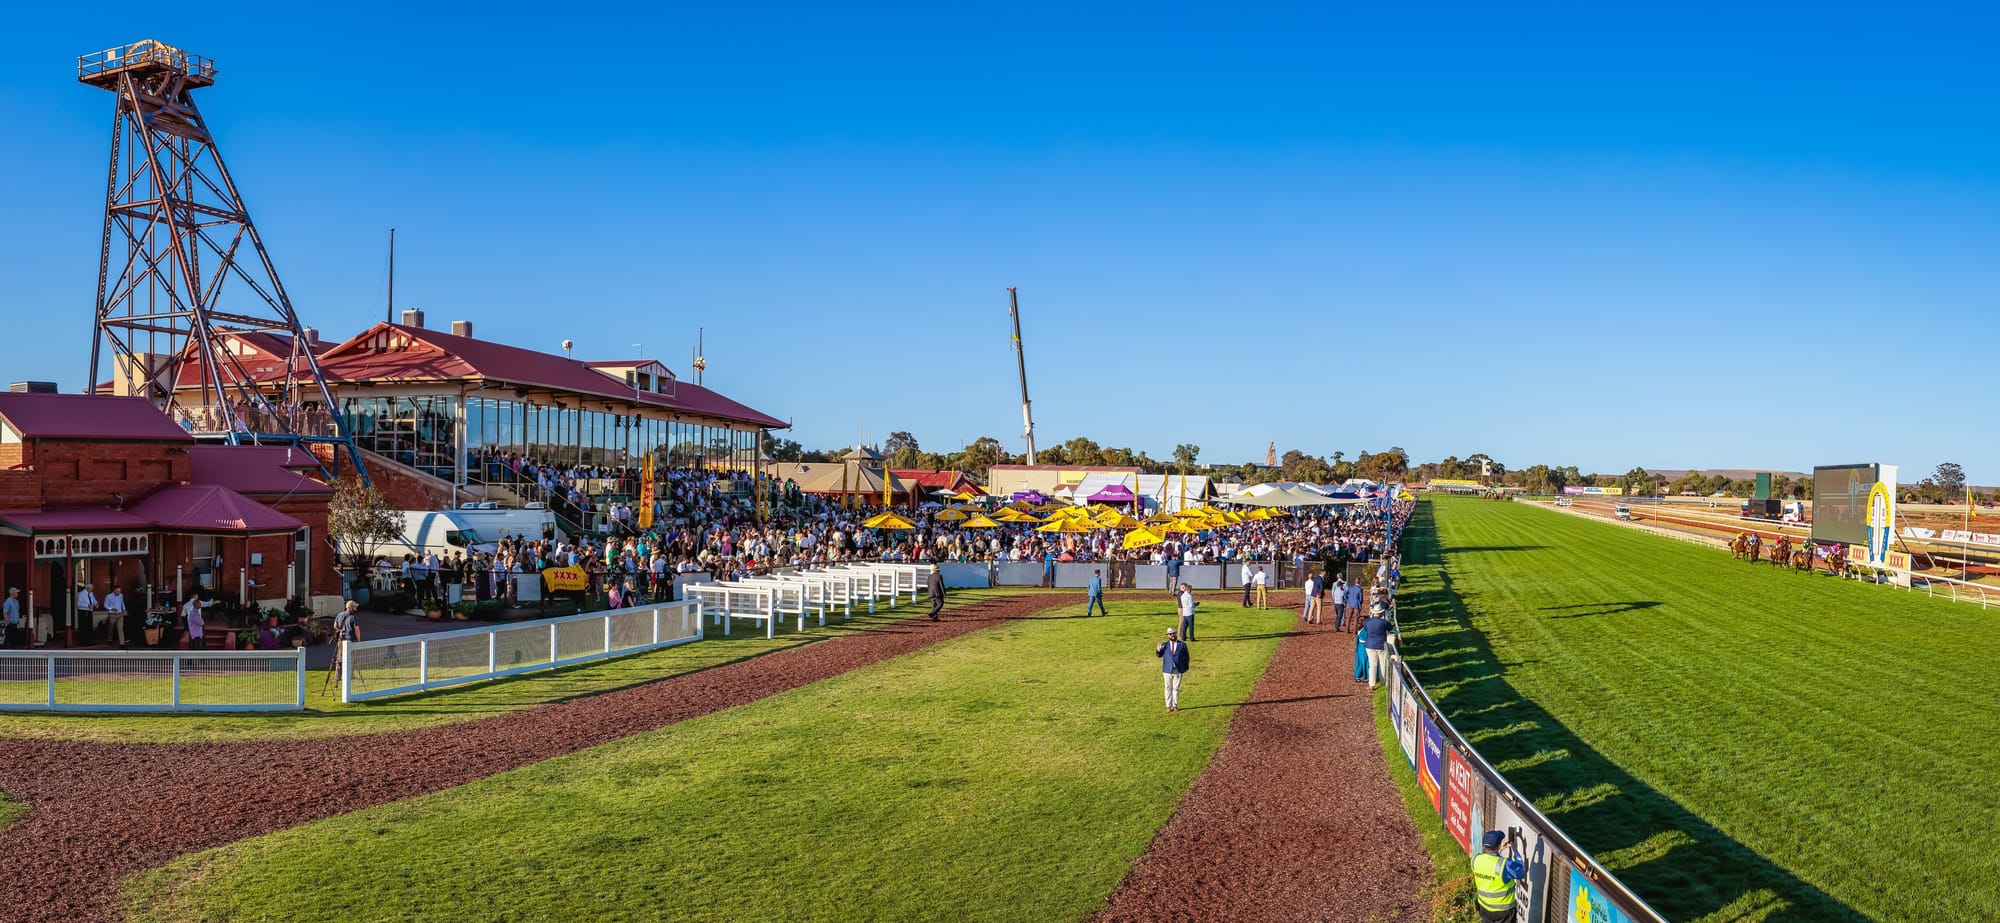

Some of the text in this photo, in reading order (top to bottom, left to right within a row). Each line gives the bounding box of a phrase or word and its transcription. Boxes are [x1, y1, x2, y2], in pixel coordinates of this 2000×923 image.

[1853, 547, 1865, 561] XXXX
[1889, 554, 1904, 569] XXXX
[553, 570, 577, 580] XXXX
[1456, 760, 1471, 795] KENT
